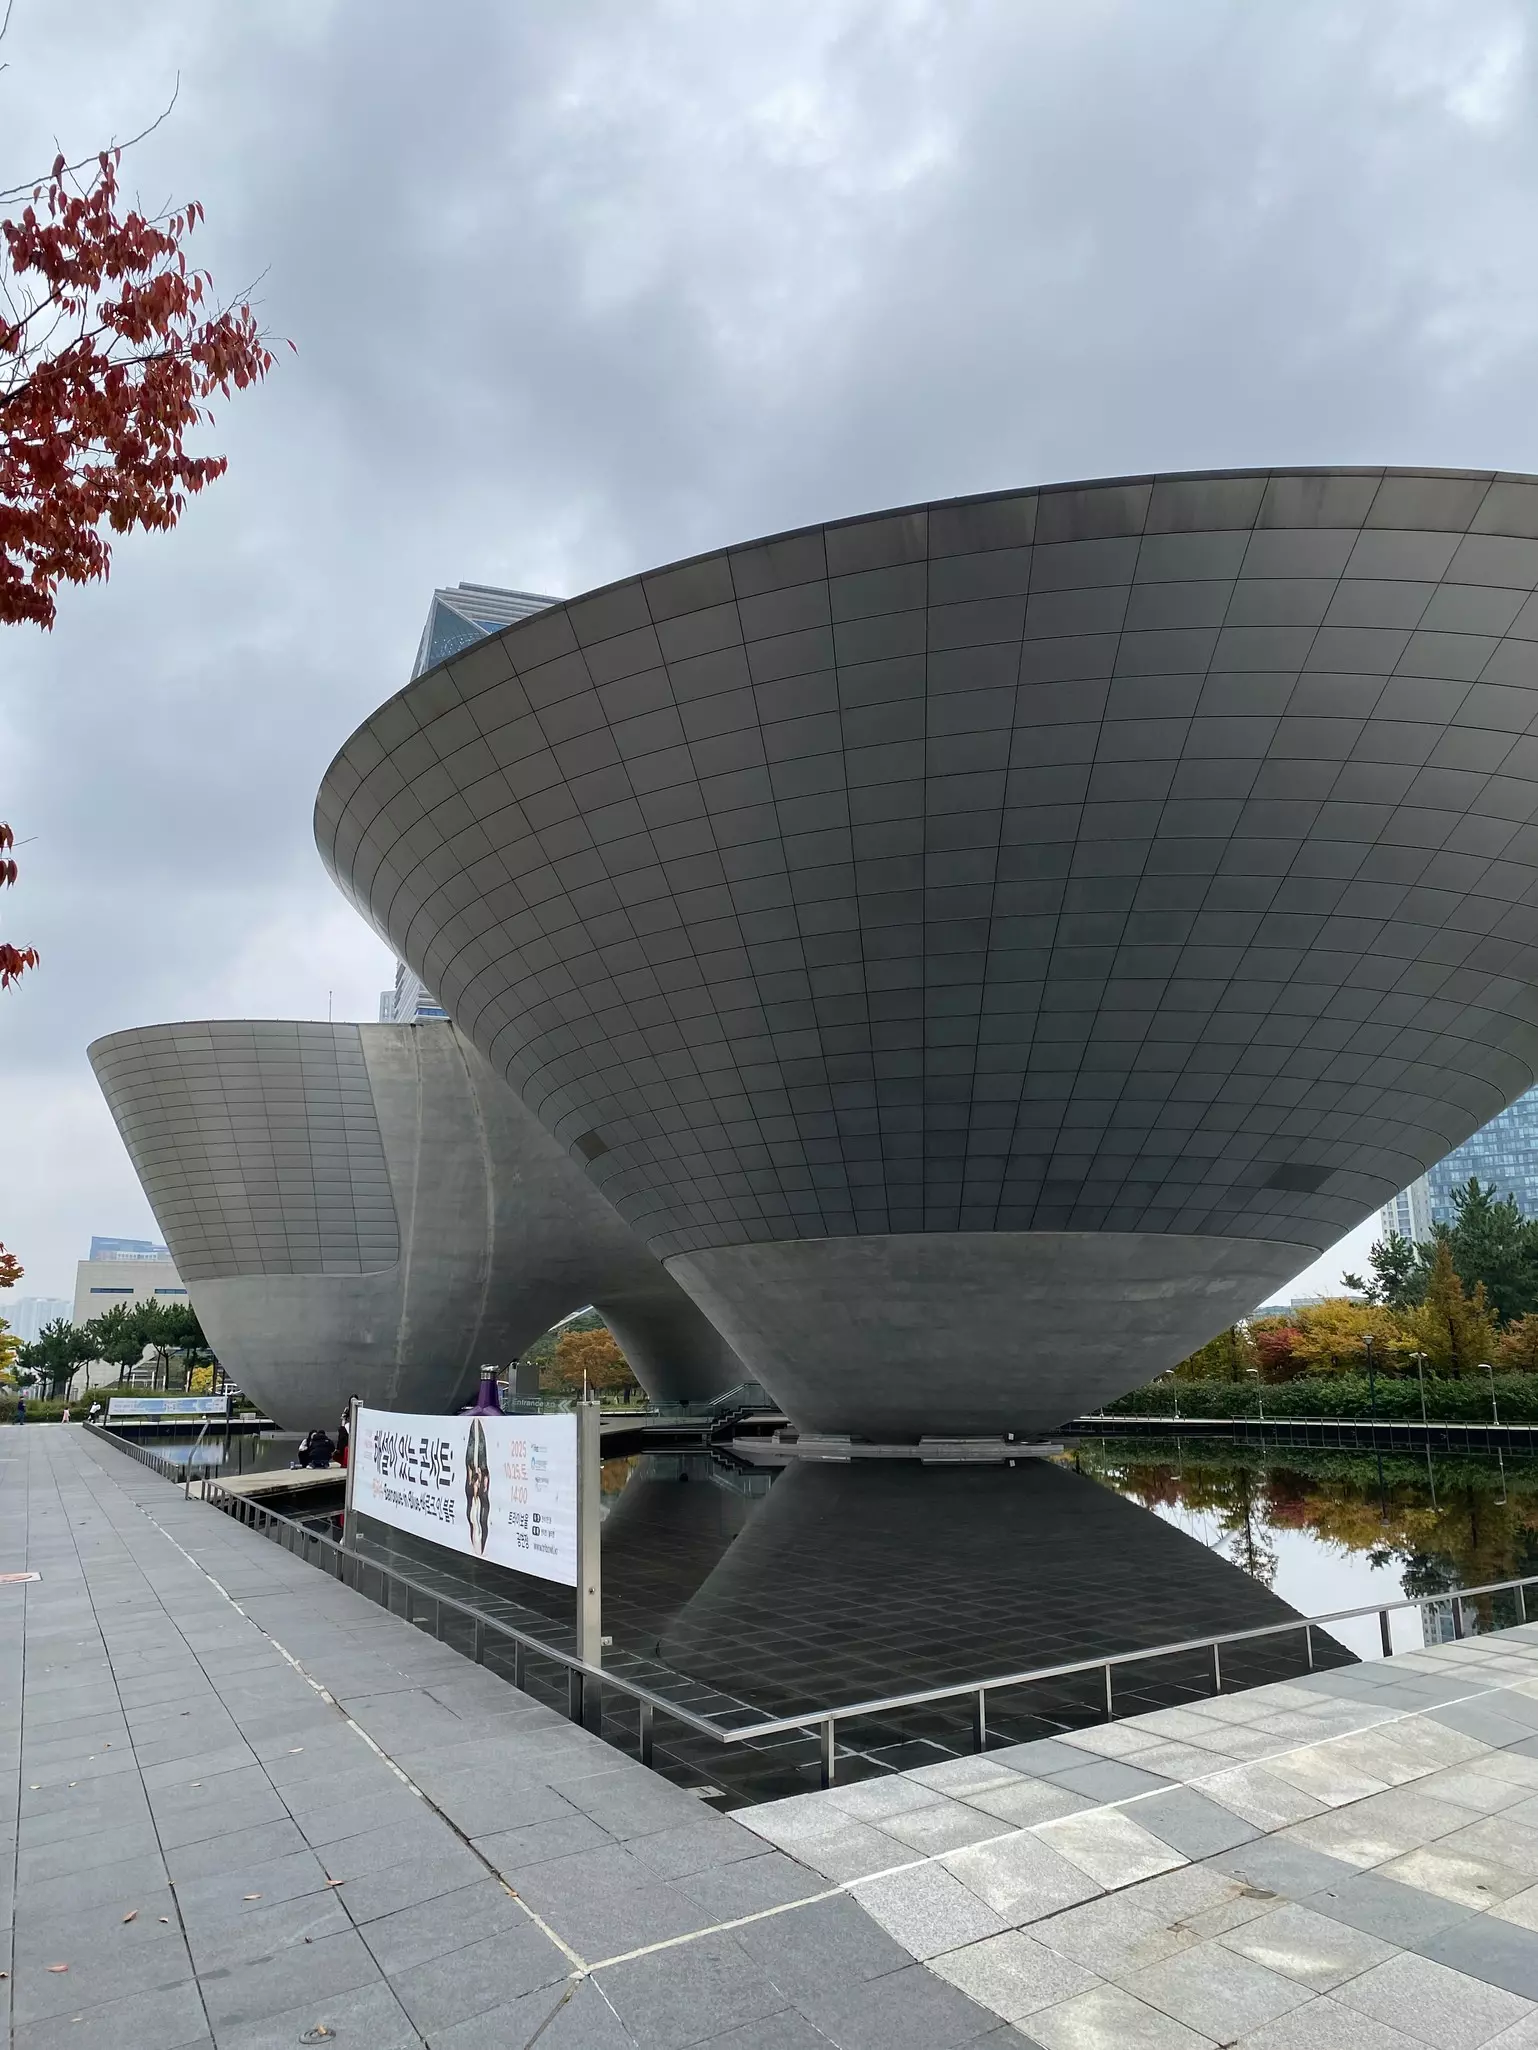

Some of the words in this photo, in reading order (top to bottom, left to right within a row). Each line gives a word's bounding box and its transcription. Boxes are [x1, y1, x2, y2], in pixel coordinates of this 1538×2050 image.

[511, 1399, 543, 1408] Entrance
[374, 1430, 397, 1478] 해설이
[399, 1434, 418, 1483] 있는
[511, 1440, 527, 1458] 2025
